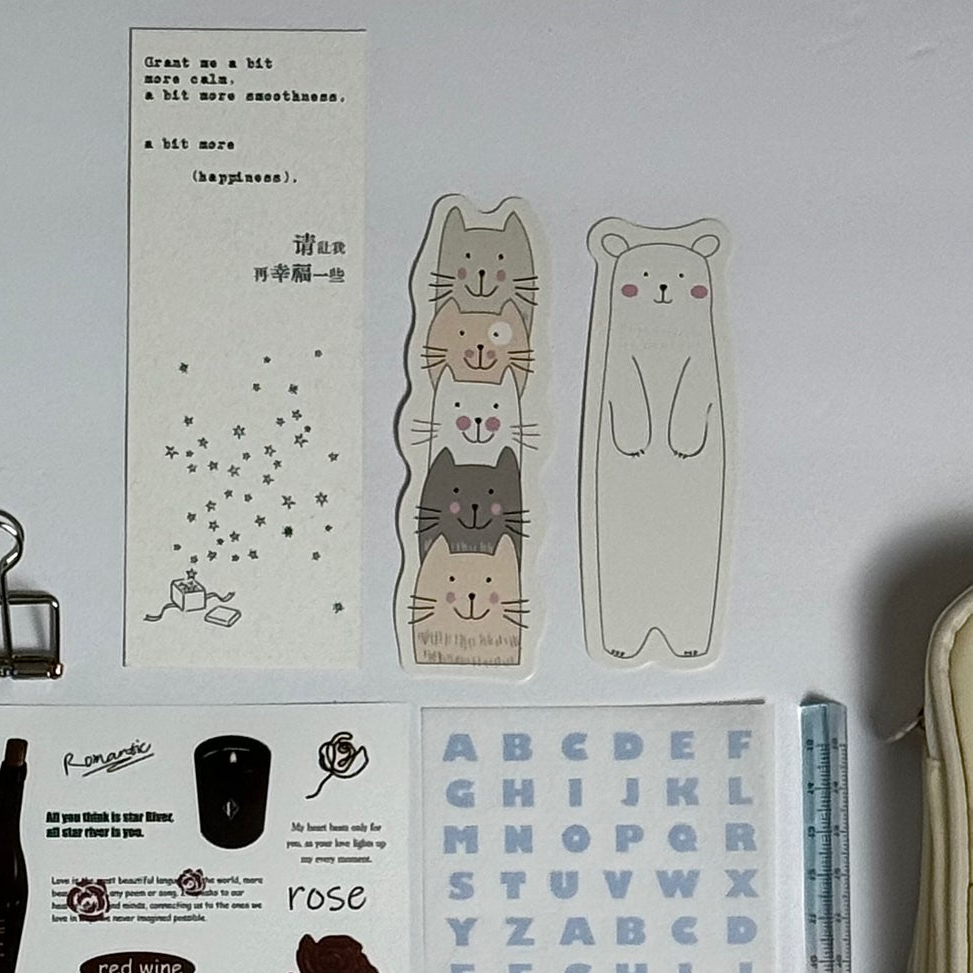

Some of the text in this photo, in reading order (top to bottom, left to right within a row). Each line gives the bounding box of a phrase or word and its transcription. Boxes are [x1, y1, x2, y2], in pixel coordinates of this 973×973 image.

[144, 56, 273, 69] Grant me a bit
[144, 74, 180, 86] more
[144, 89, 154, 103] a
[163, 89, 189, 103] bit
[199, 89, 235, 103] more
[144, 138, 235, 150] a bit more
[253, 263, 345, 283] 再幸福一些
[64, 739, 151, 775] Romantic
[443, 729, 753, 762] A B C D E F
[446, 779, 474, 808] G
[503, 779, 535, 807] H
[621, 778, 640, 806] J
[666, 778, 698, 807] K
[729, 778, 753, 806] L
[62, 811, 81, 823] you
[83, 811, 109, 823] think
[111, 811, 121, 823] is
[123, 811, 144, 823] star
[443, 826, 479, 854] M
[504, 826, 534, 855] N
[615, 824, 643, 852] P
[668, 824, 698, 852] Q
[726, 822, 757, 851] R
[449, 869, 760, 901] S T U V W X
[288, 886, 367, 911] rose
[446, 915, 756, 947] Y Z A B C D
